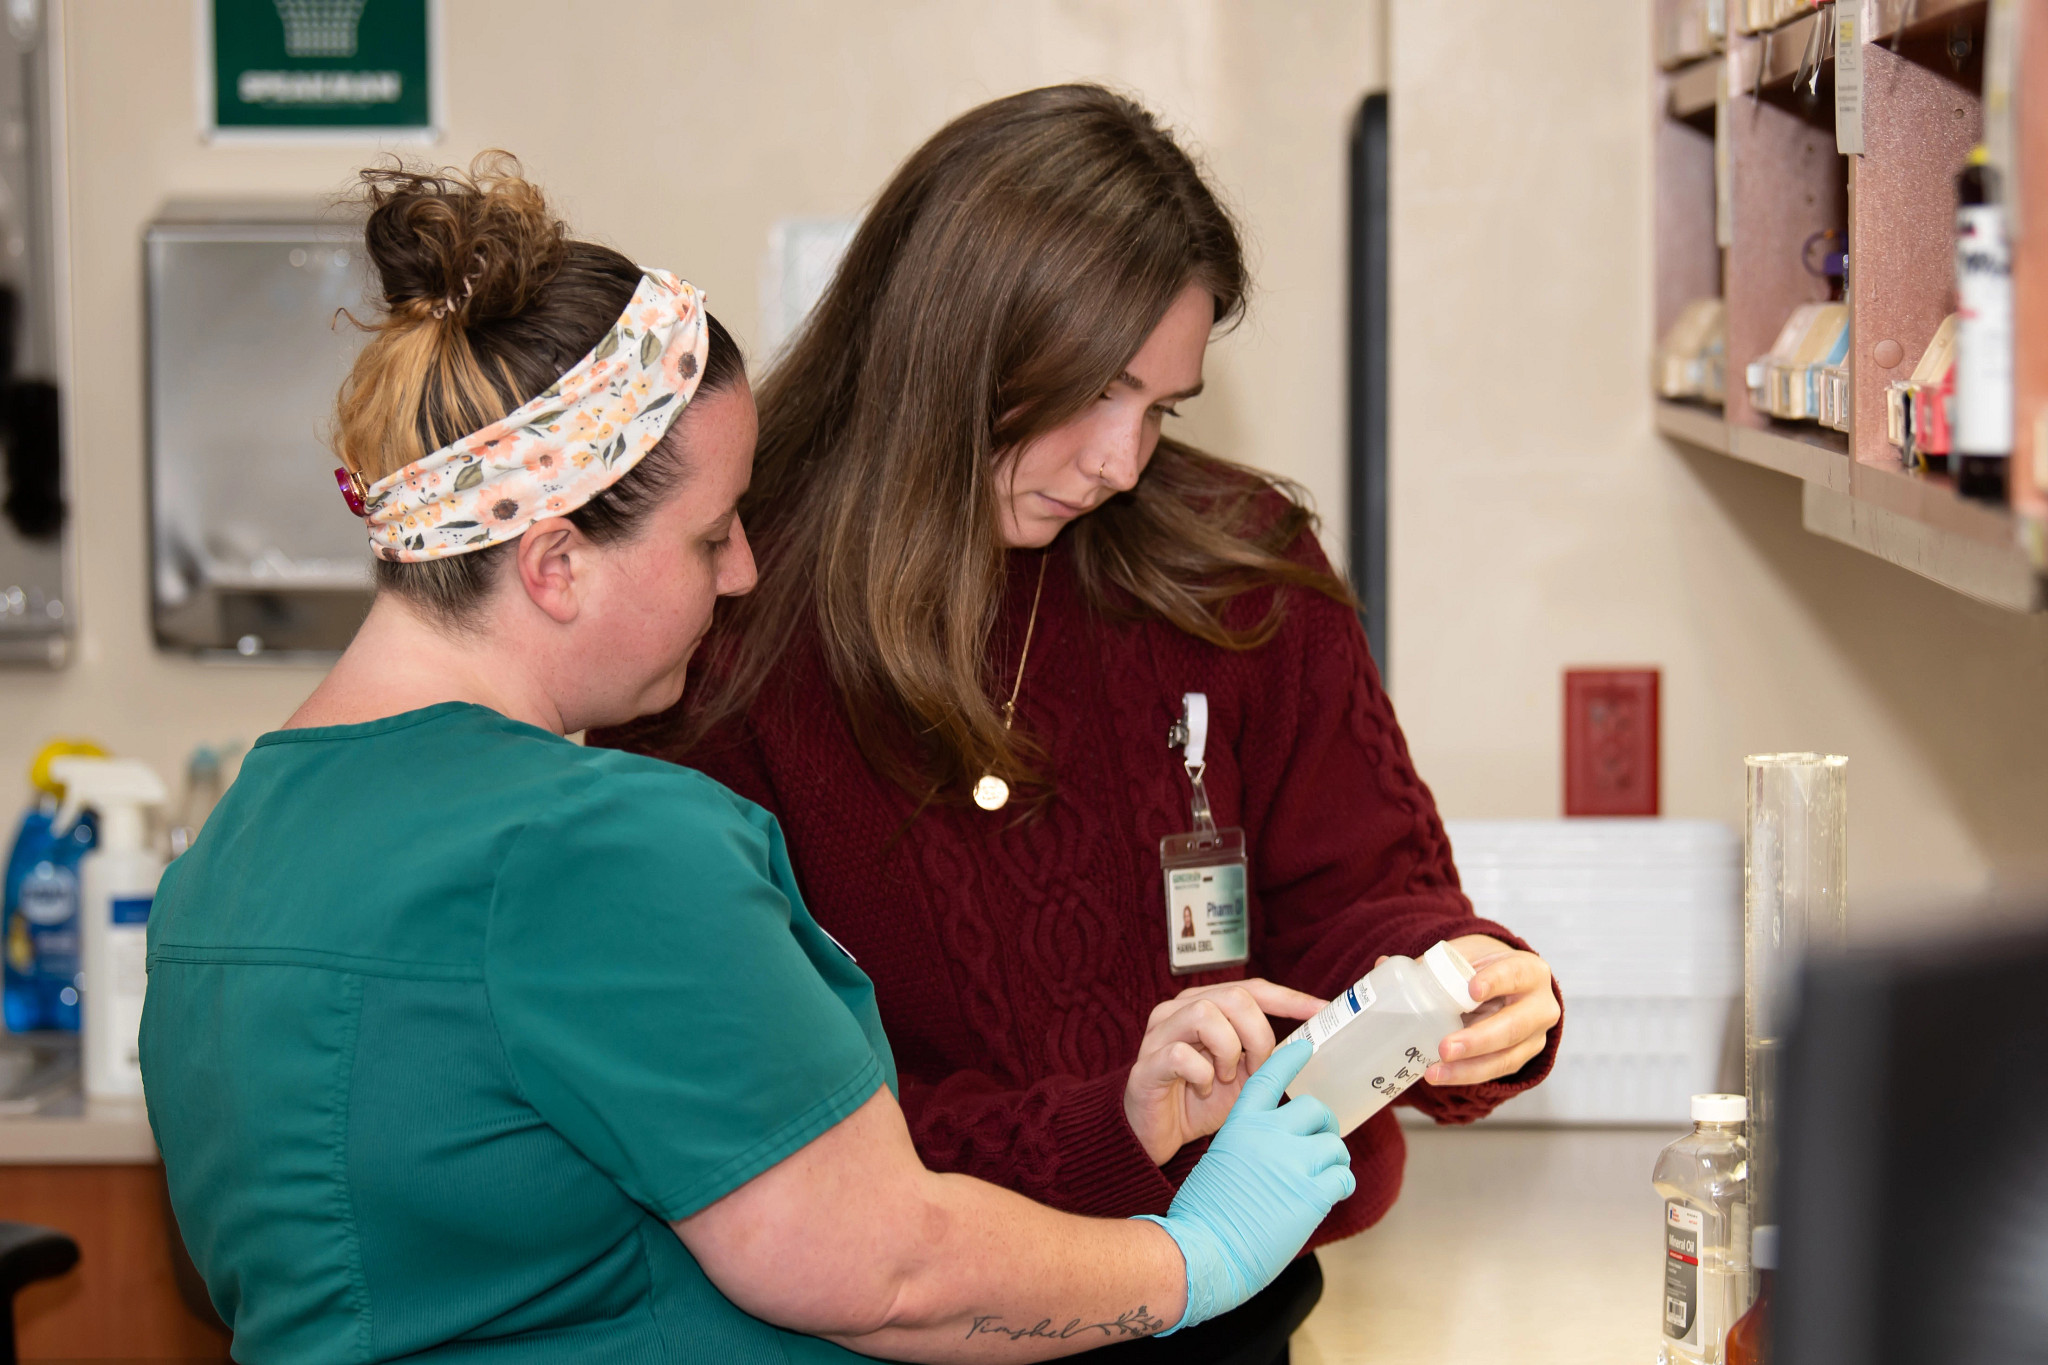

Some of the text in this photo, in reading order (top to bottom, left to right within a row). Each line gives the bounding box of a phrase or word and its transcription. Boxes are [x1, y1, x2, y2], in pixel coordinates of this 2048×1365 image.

[1668, 1233, 1695, 1253] Mineral Oil
[965, 1315, 1081, 1340] Timshel
